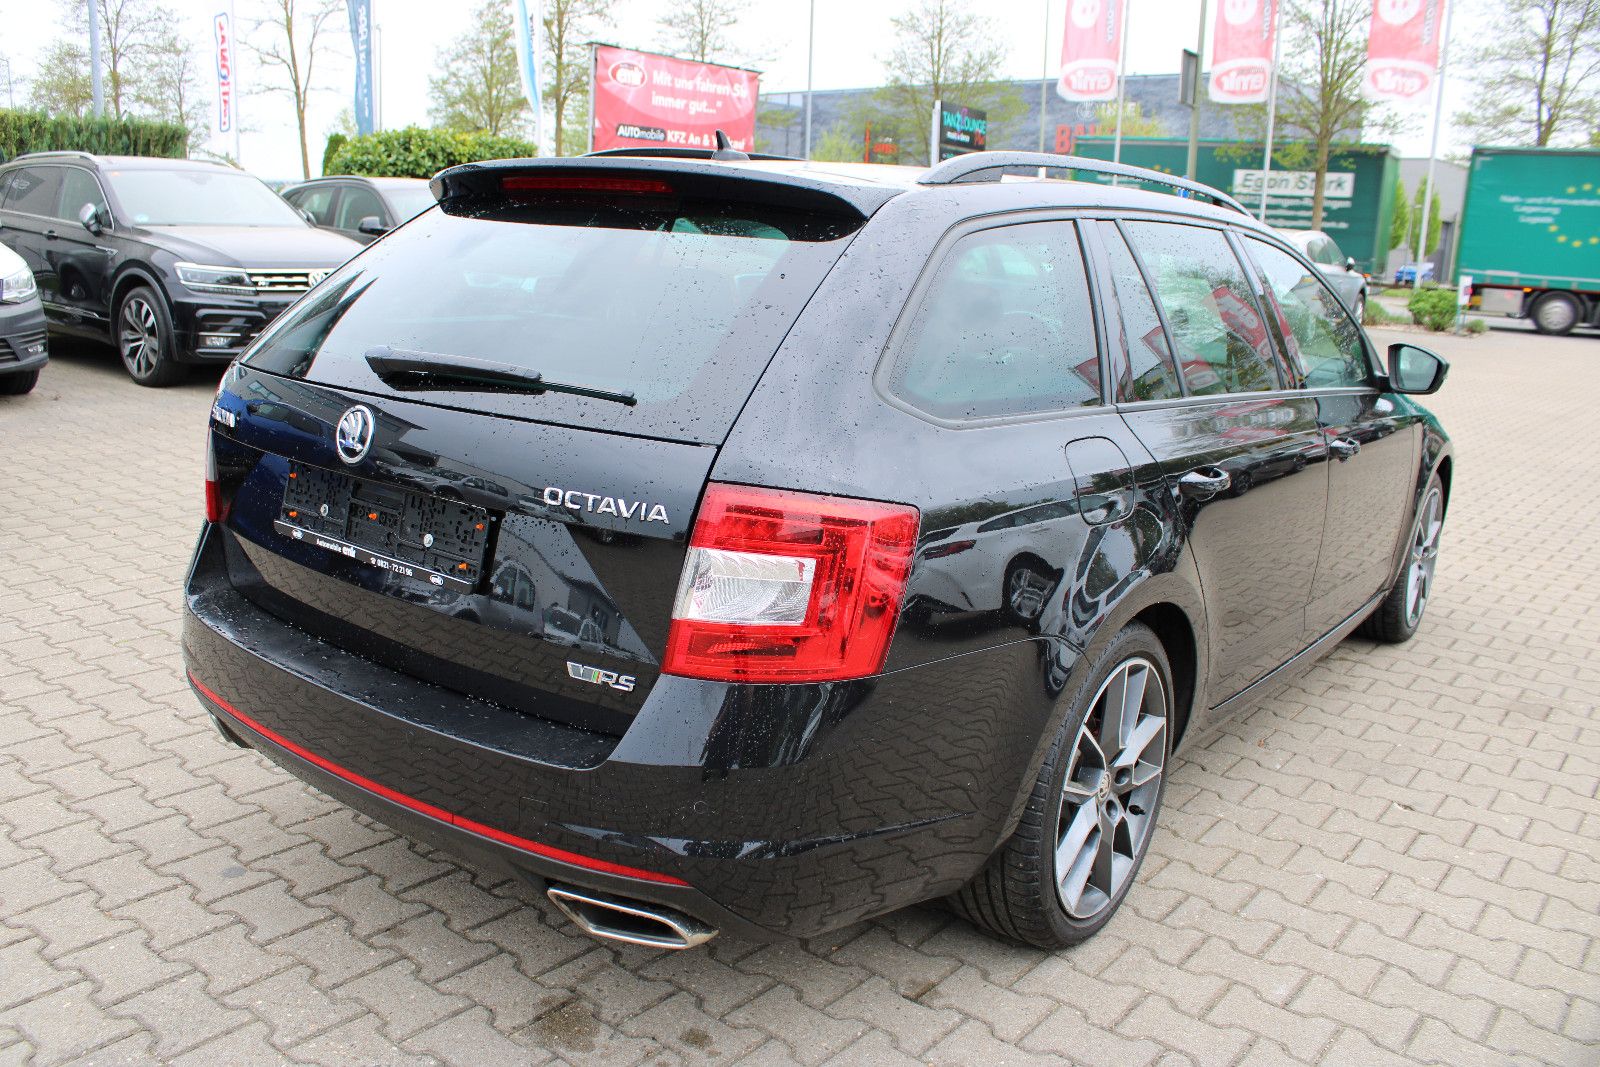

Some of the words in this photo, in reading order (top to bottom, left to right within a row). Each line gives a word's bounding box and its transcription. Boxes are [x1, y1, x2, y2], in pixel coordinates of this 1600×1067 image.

[653, 70, 672, 87] Mit
[674, 77, 694, 90] uns
[696, 76, 730, 96] fahren
[667, 130, 686, 143] KFZ
[688, 133, 701, 145] An
[702, 134, 710, 146] &
[1296, 174, 1347, 191] Strk
[543, 487, 670, 525] OCTAVIA
